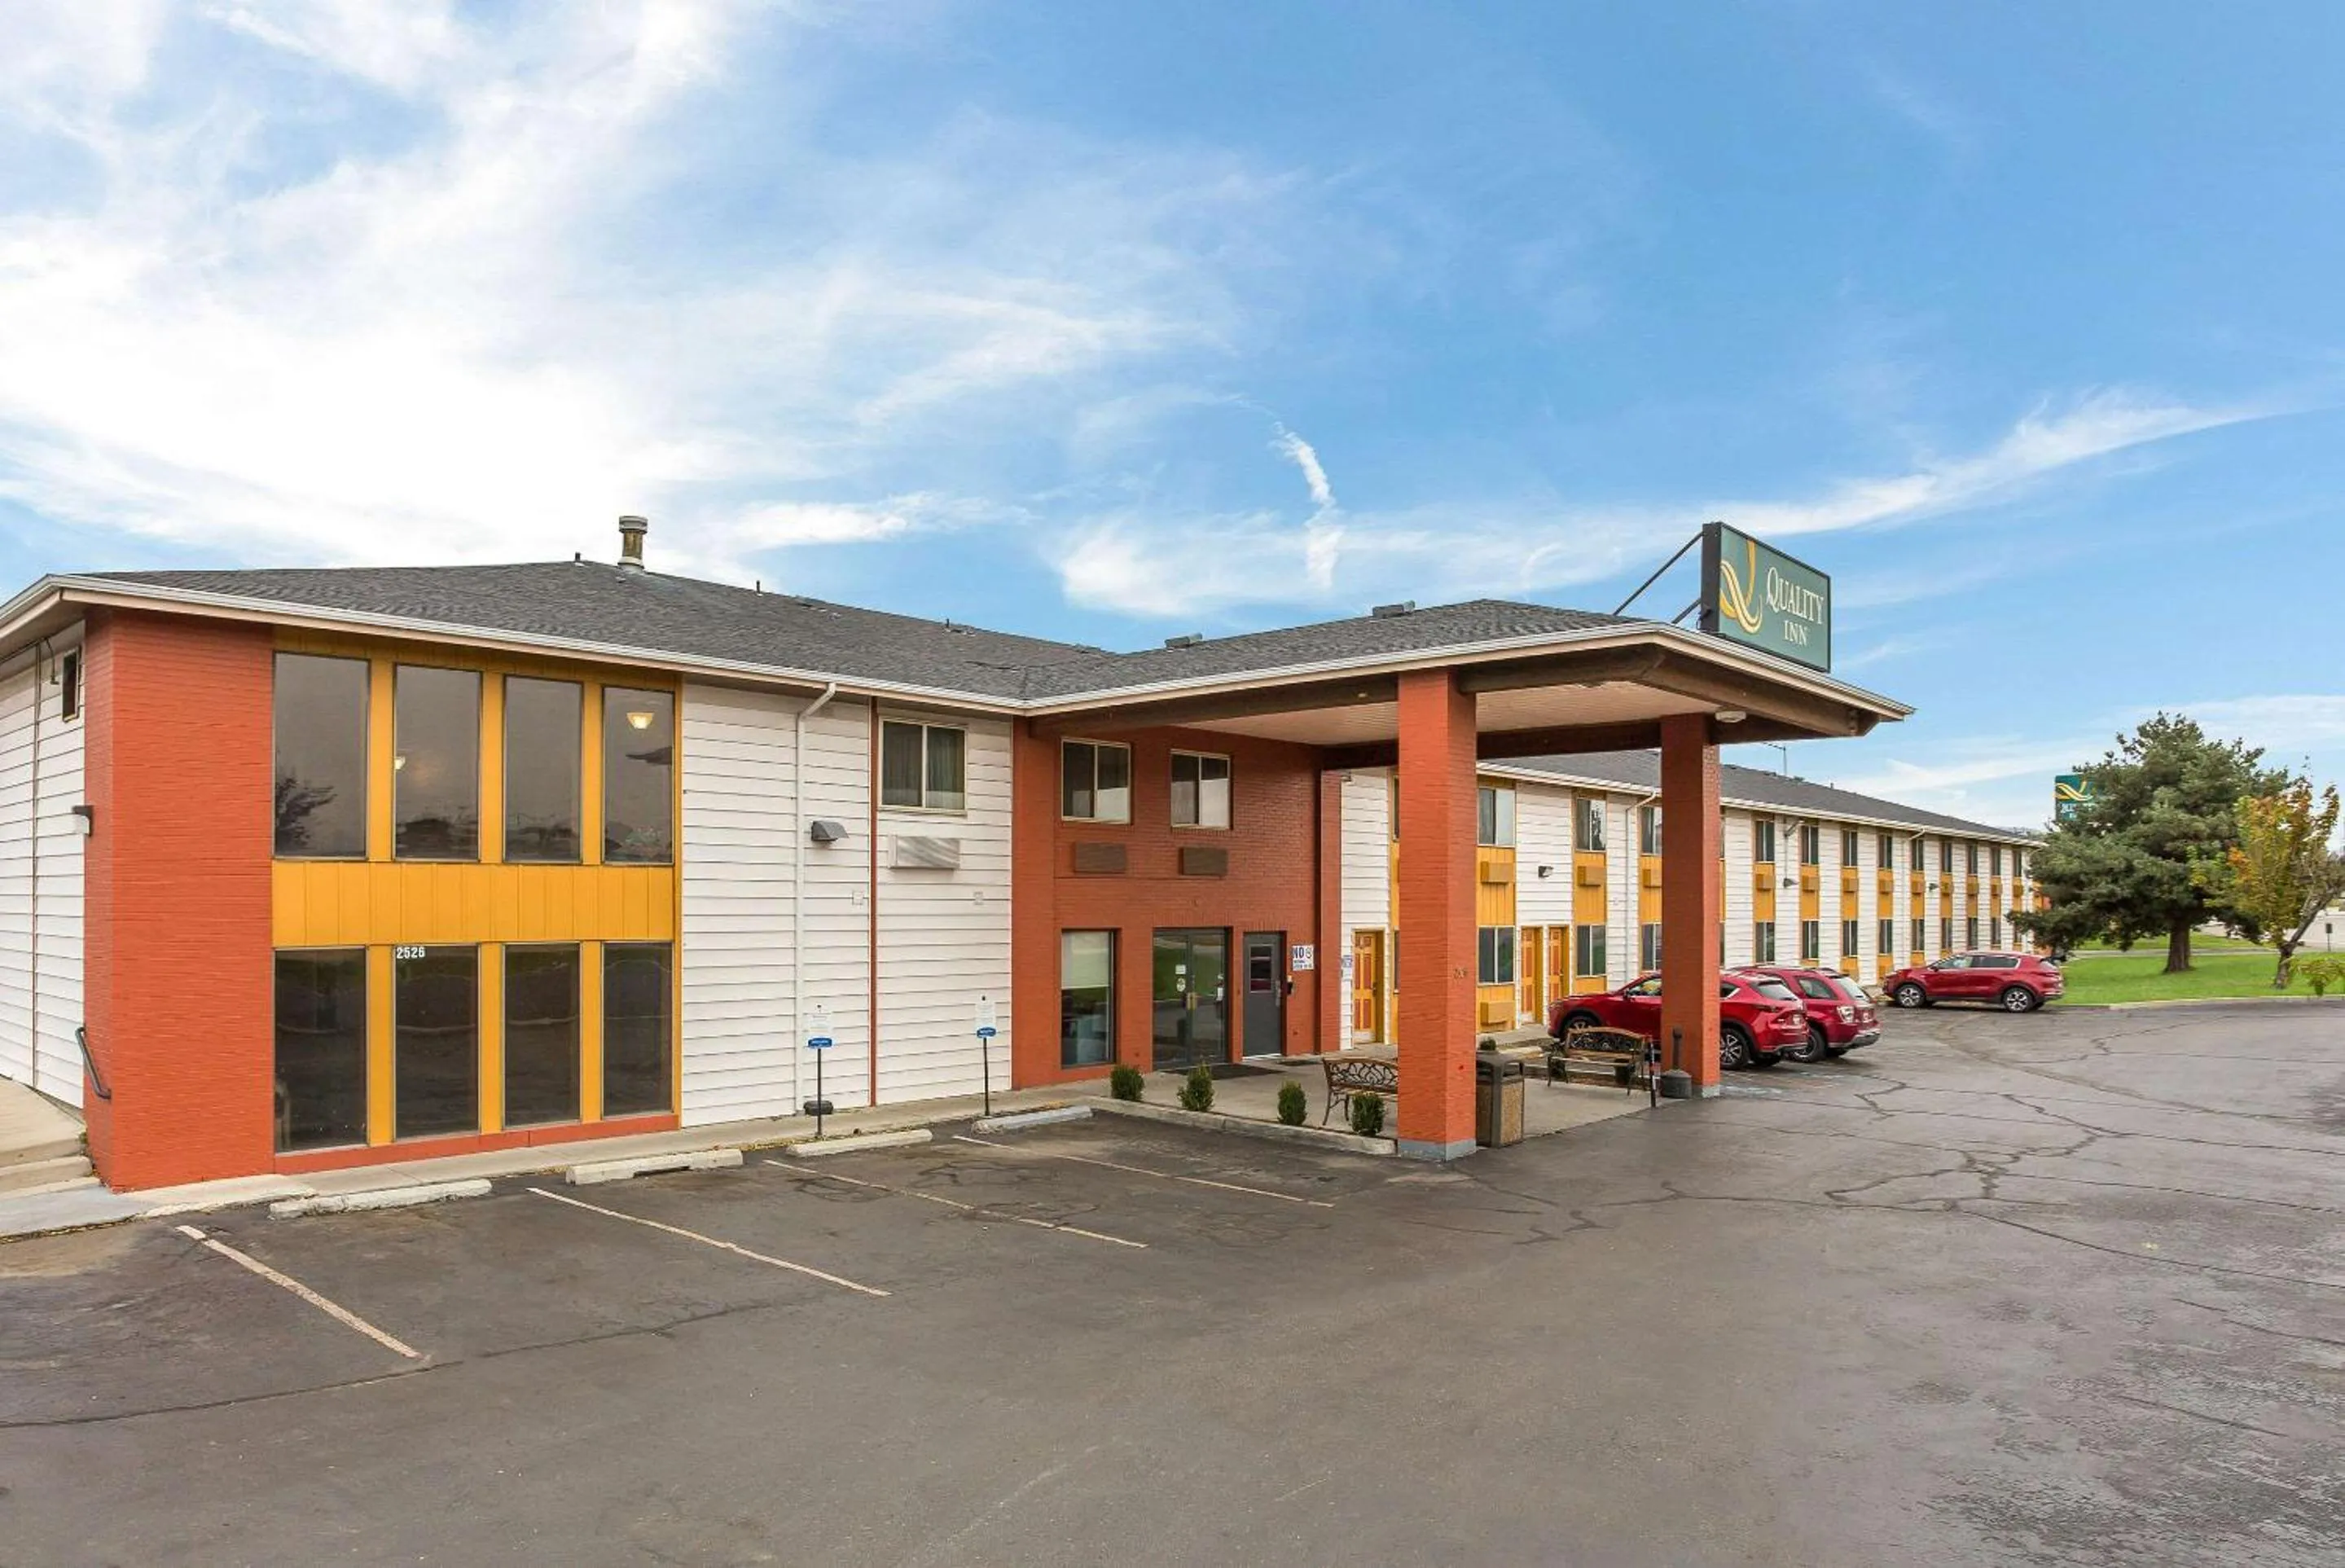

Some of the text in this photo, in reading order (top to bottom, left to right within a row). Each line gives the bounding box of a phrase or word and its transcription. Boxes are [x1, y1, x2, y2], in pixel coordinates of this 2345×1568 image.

[1767, 568, 1824, 624] QUALITY
[1784, 621, 1807, 645] INN
[397, 947, 425, 959] 2526
